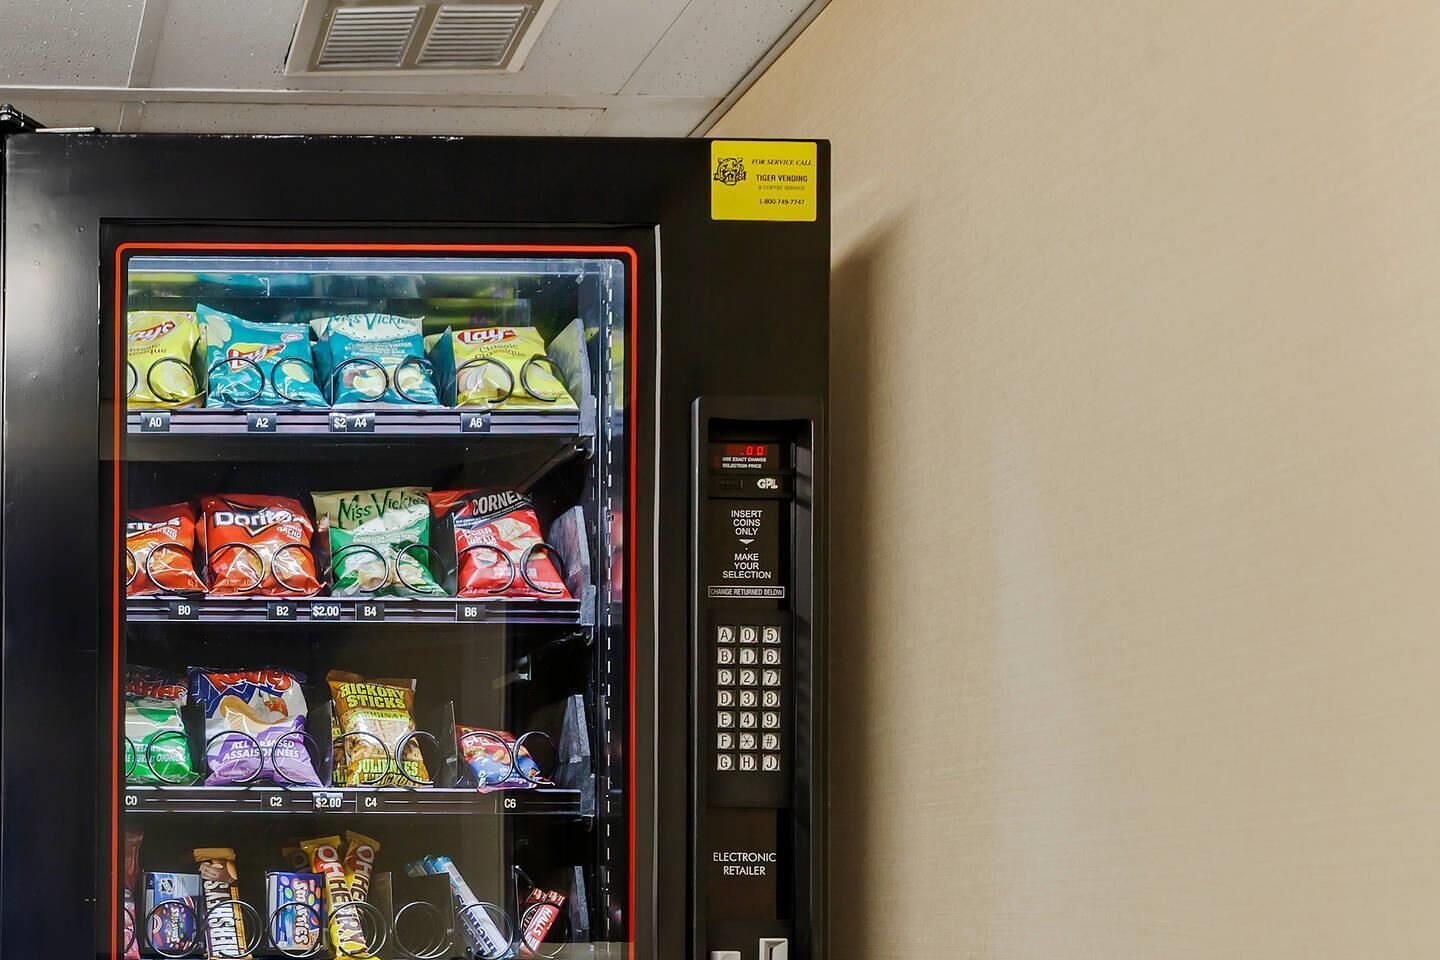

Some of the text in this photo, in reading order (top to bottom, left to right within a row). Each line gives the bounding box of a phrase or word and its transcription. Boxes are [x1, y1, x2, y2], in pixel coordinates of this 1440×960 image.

[756, 174, 808, 183] TIGER VENDING
[149, 416, 162, 429] A0
[256, 416, 269, 429] A2
[354, 417, 367, 428] A4
[469, 417, 483, 429] A6
[756, 477, 779, 490] GPL
[730, 510, 763, 518] INSERT
[733, 518, 761, 527] COINS
[735, 527, 759, 536] ONLY
[734, 553, 759, 561] MAKE
[734, 562, 760, 570] YOUR
[722, 571, 772, 579] SELECTION
[733, 588, 763, 596] RETURNED
[763, 588, 783, 596] BELOW
[177, 605, 191, 616] B0
[276, 606, 289, 616] B2
[312, 606, 339, 617] $2.00
[364, 606, 377, 617] B4
[464, 606, 477, 617] B6
[720, 629, 729, 640] A
[766, 630, 774, 640] 5
[721, 650, 774, 661] B 1 6
[720, 671, 773, 683] C 2 7
[340, 682, 405, 699] HICKORY
[346, 694, 406, 709] STICKS
[721, 693, 773, 704] D 3 8
[721, 714, 773, 725] E 4 9
[231, 740, 250, 749] ALL
[721, 735, 728, 746] F
[720, 757, 773, 769] G H J
[125, 795, 138, 806] C0
[269, 797, 283, 807] C2
[315, 796, 342, 808] $2.00
[364, 797, 378, 808] C4
[504, 798, 517, 809] C6
[713, 852, 777, 863] ELECTRONIC
[723, 866, 766, 876] RETAILER
